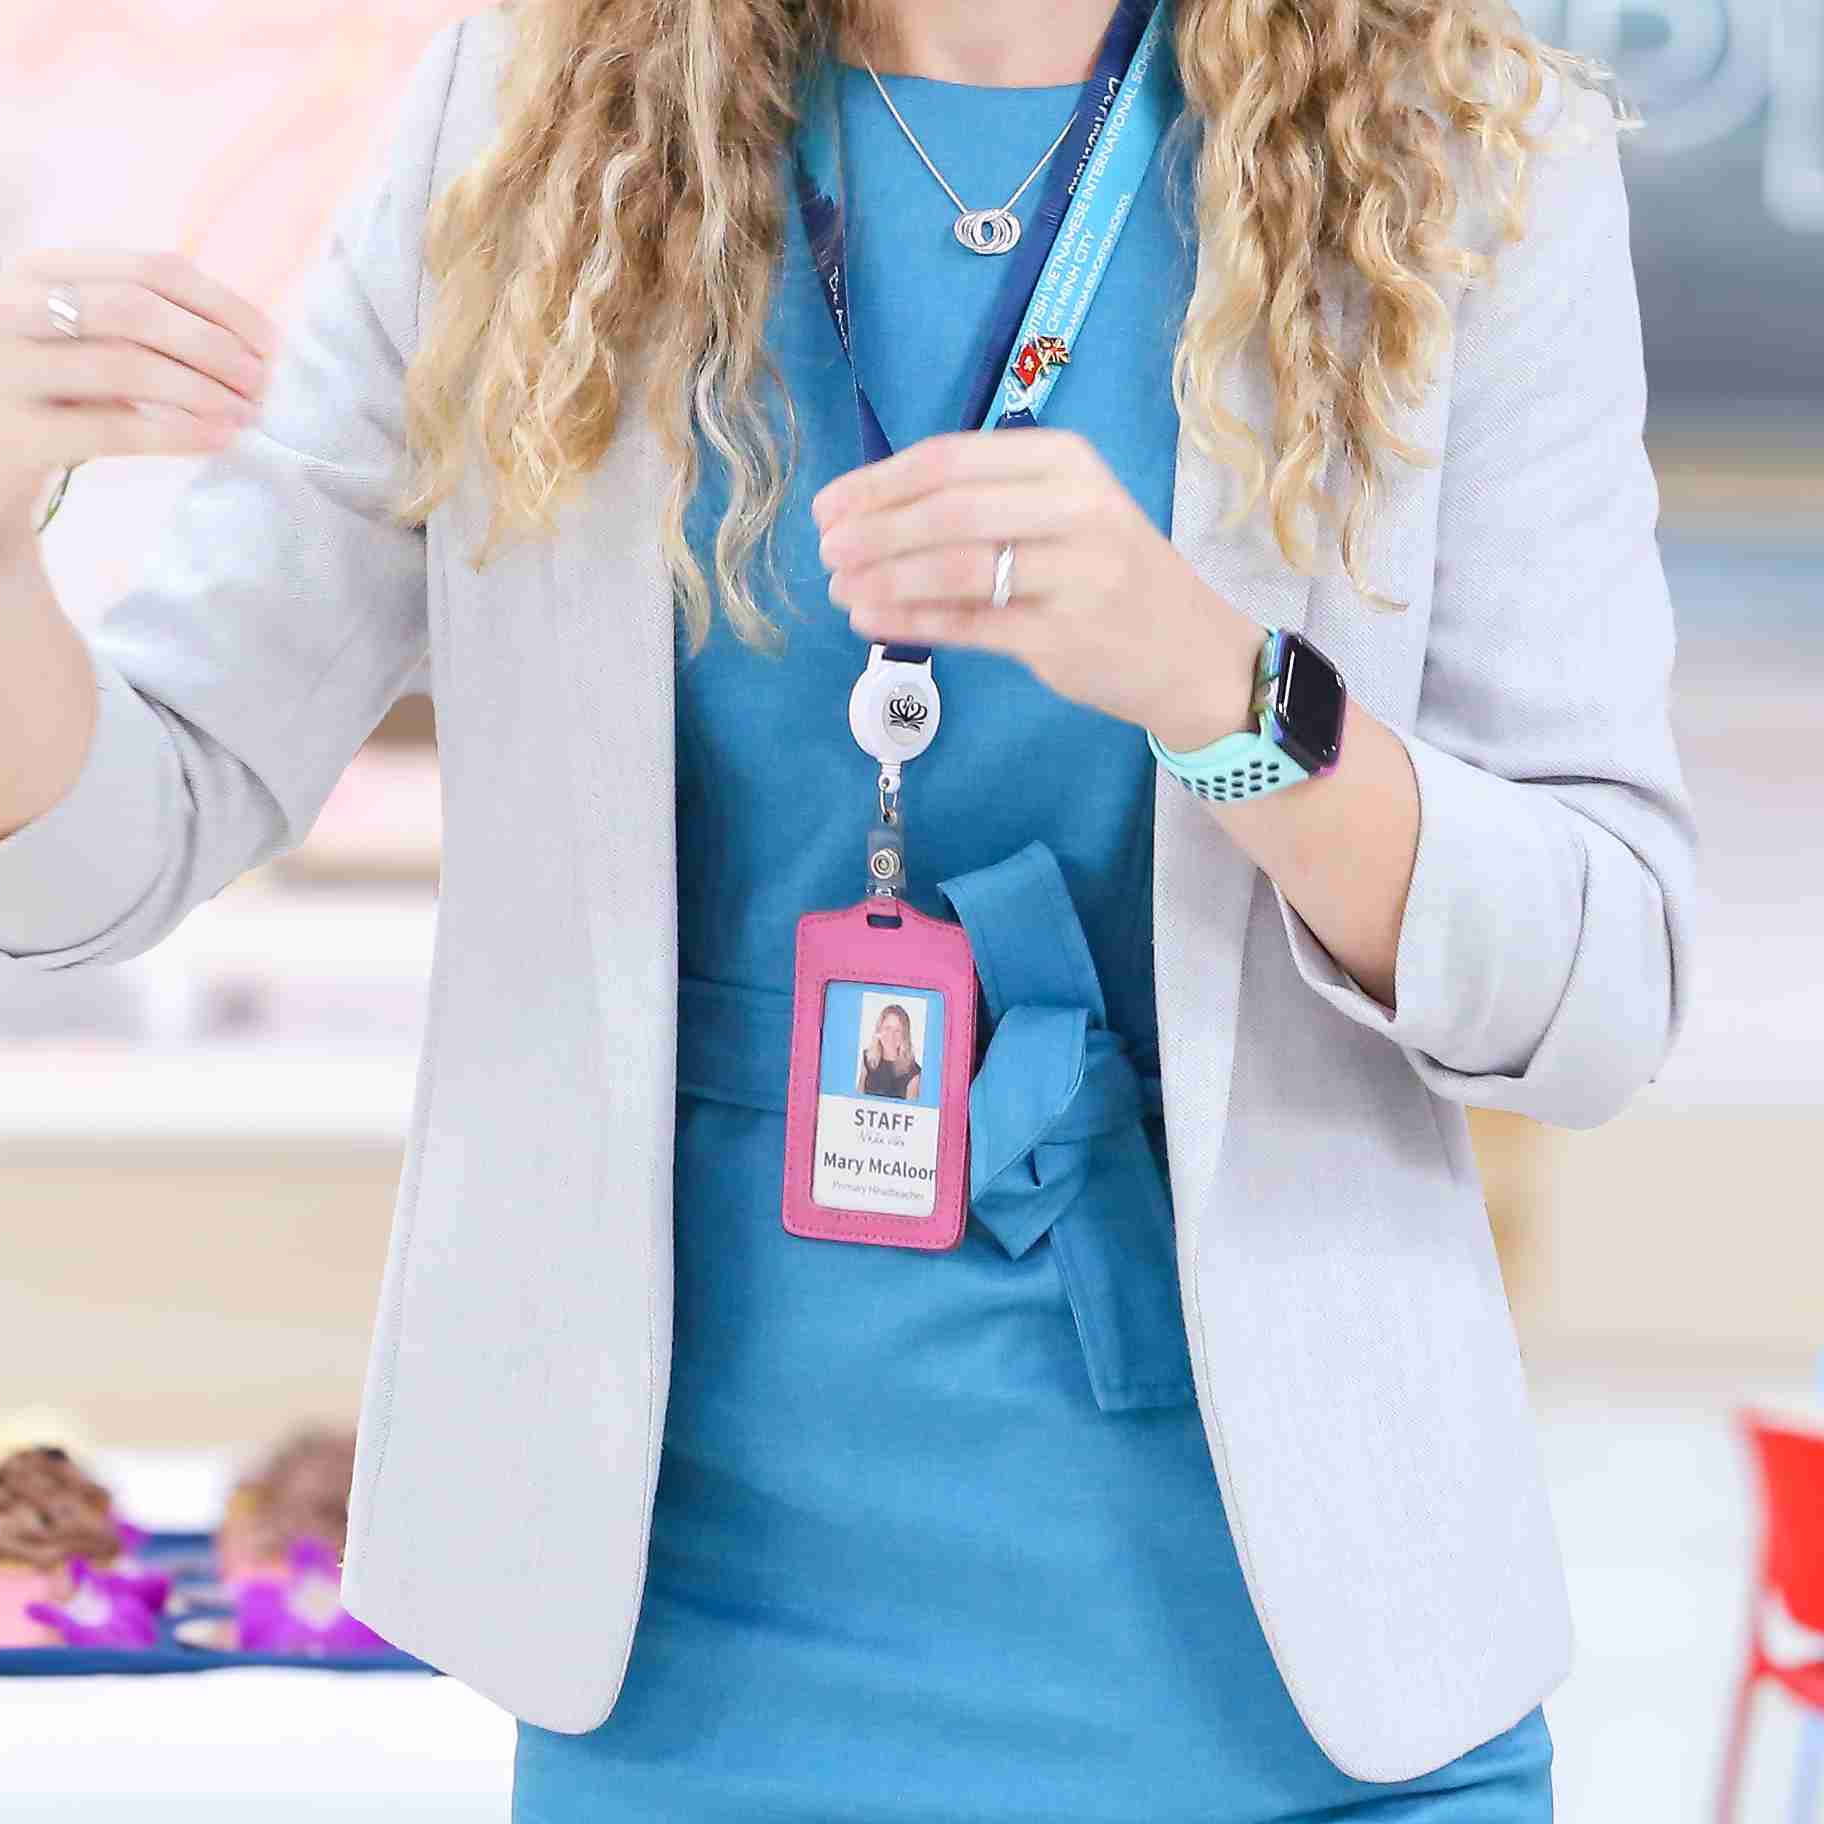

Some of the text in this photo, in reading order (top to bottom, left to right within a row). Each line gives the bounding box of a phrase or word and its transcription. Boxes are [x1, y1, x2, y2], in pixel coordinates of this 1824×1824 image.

[1042, 199, 1091, 294] VIETNAMESE
[1083, 84, 1138, 199] INTERNATIONAL
[1054, 262, 1081, 304] MINH
[1072, 227, 1095, 264] CITY
[854, 1108, 914, 1132] STAFF
[823, 1151, 865, 1175] Mary
